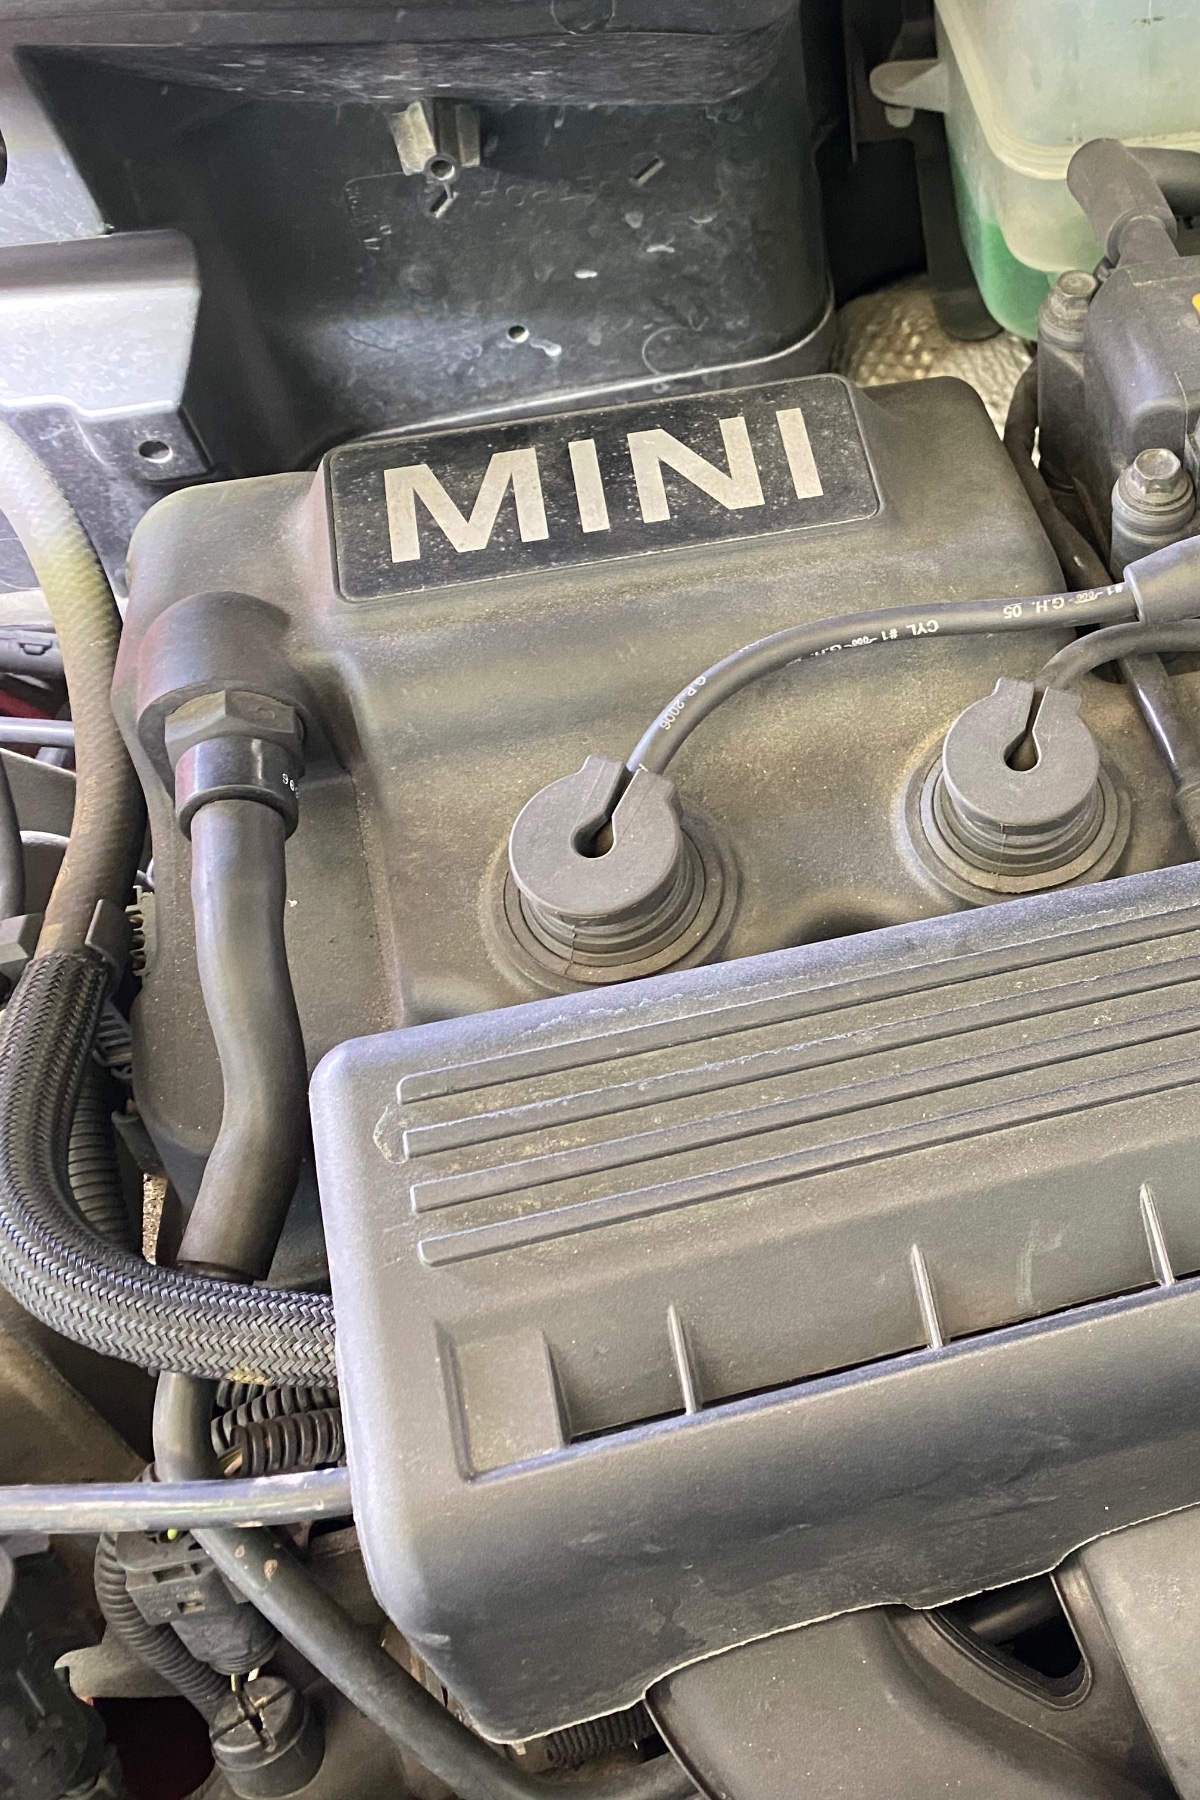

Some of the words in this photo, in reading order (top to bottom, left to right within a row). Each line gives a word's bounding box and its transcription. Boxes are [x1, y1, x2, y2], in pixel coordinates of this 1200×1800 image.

[384, 407, 824, 563] MINI
[1001, 602, 1023, 618] 05
[879, 627, 898, 640] #1
[905, 618, 939, 636] CYL
[658, 698, 686, 731] 2006
